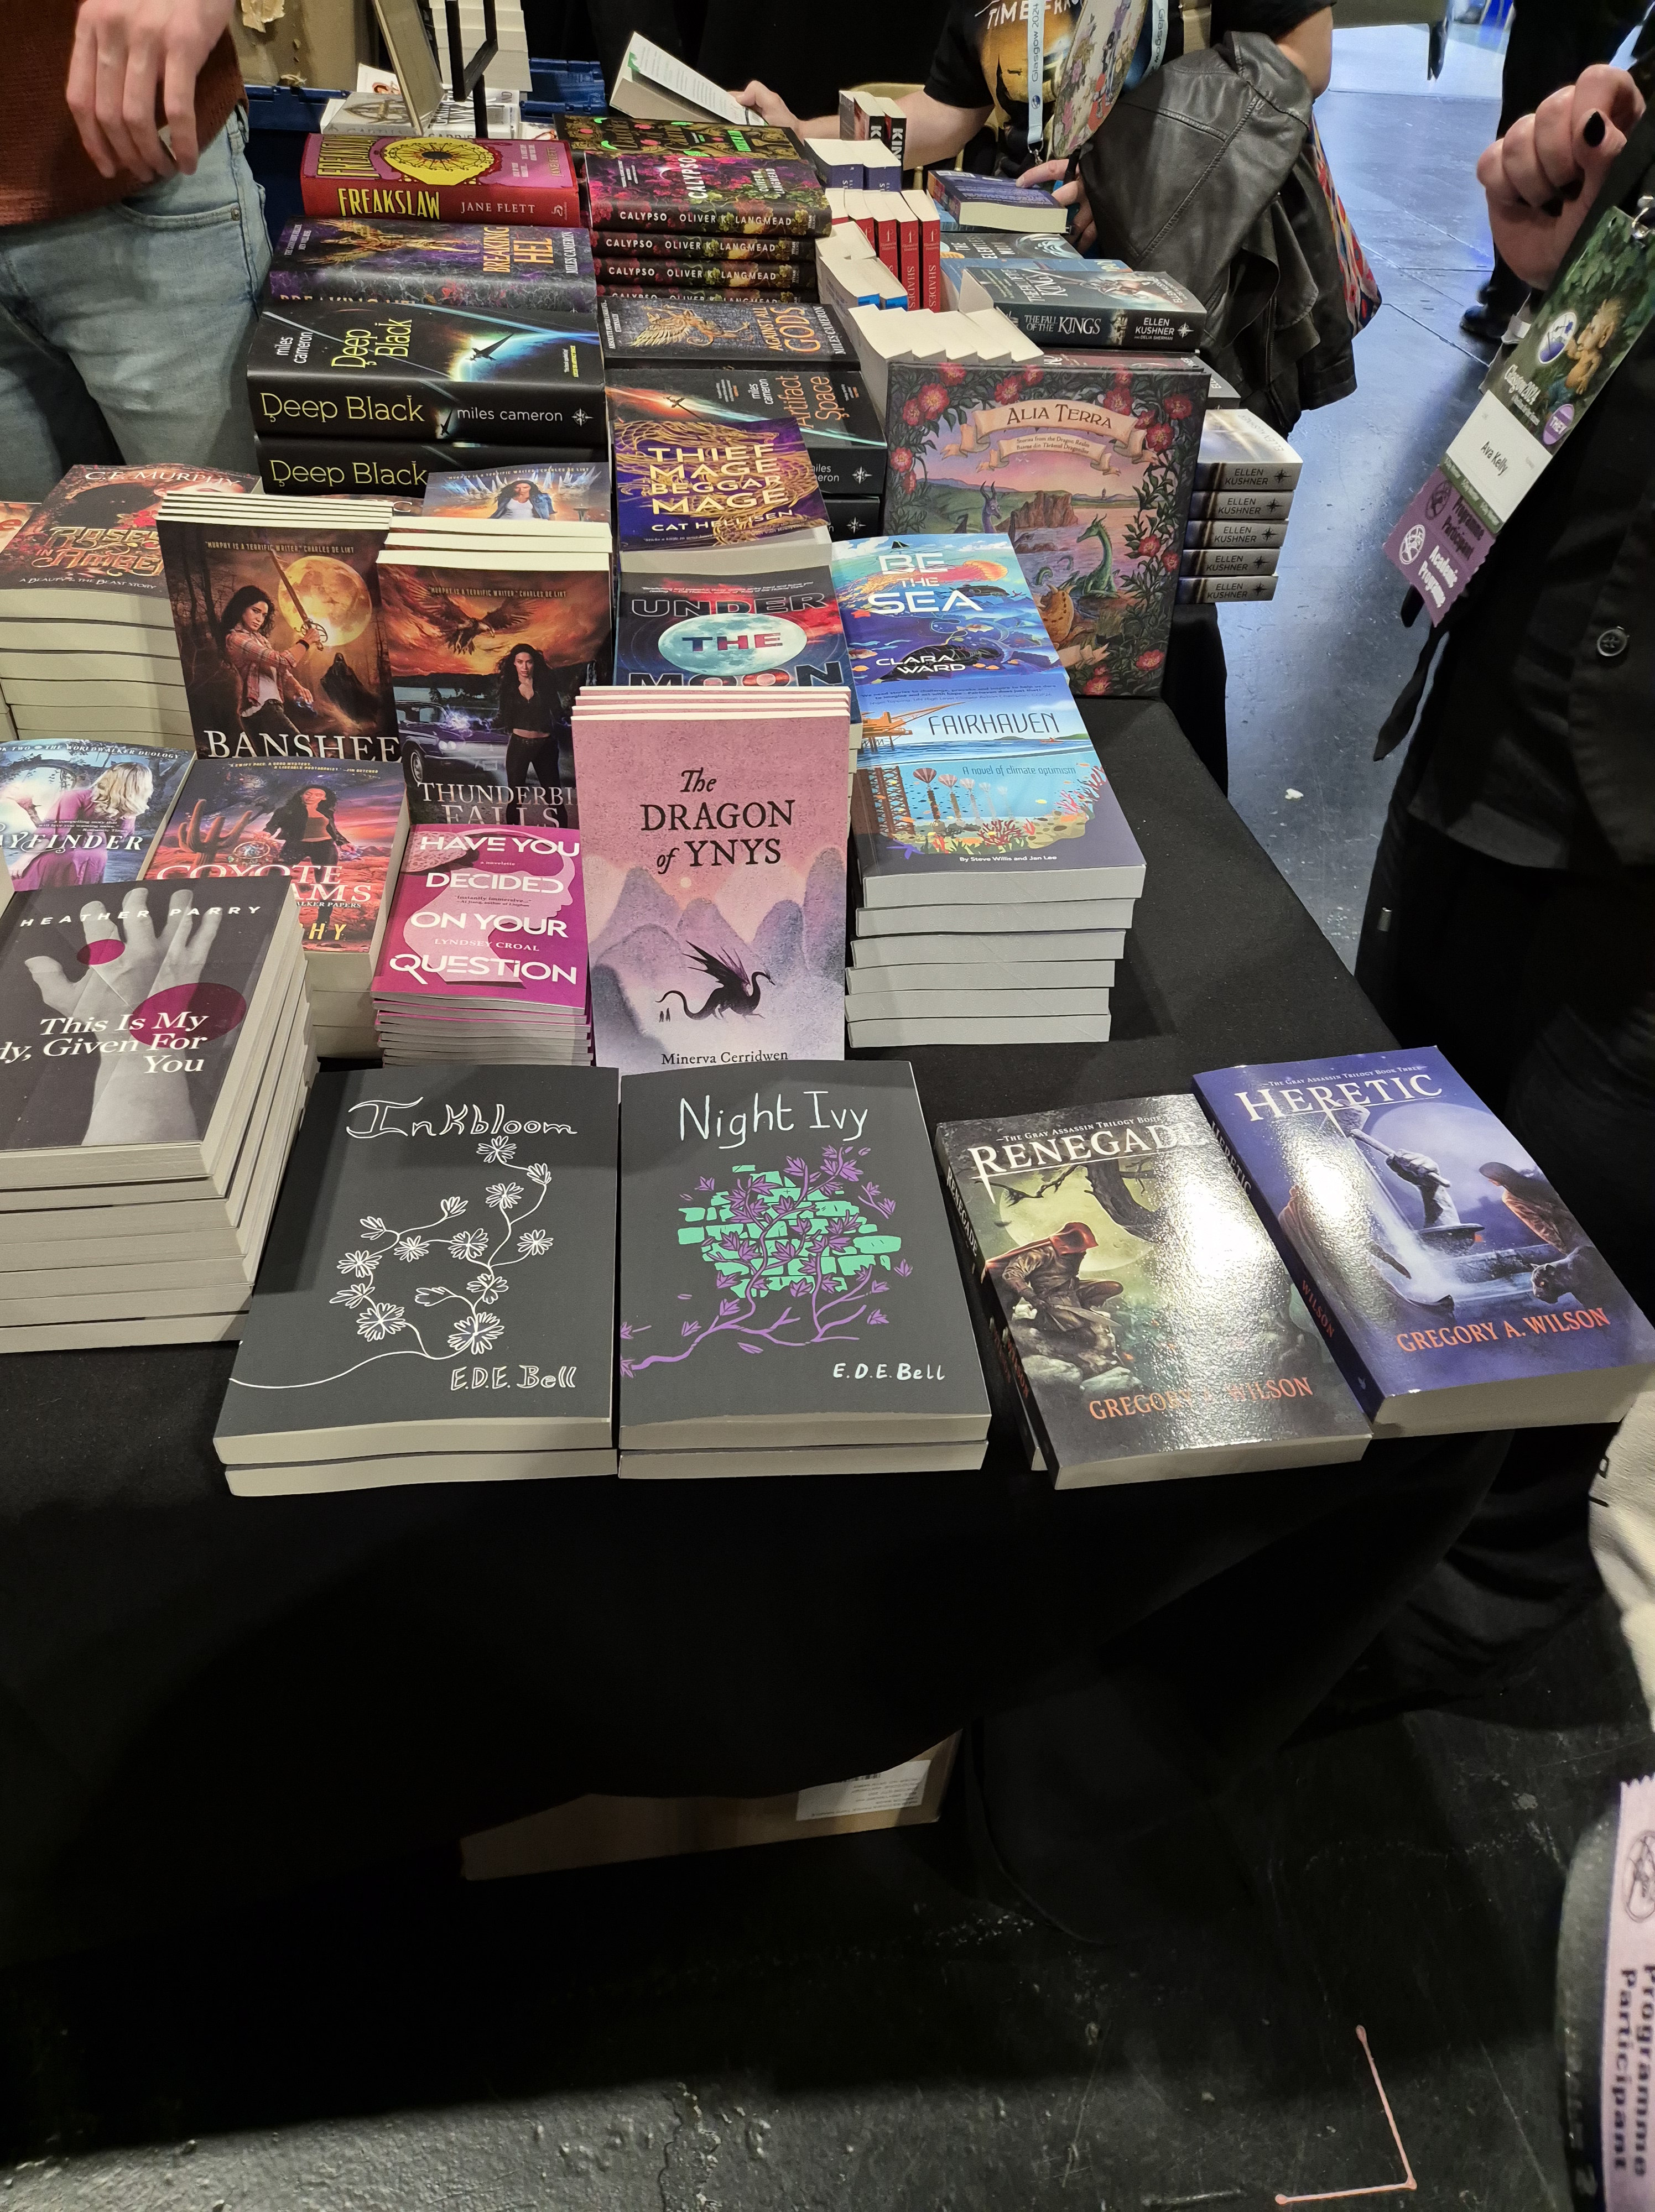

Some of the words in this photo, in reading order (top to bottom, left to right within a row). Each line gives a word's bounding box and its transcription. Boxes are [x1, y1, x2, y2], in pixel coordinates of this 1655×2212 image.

[1154, 8, 1165, 63] Glasgow
[1032, 31, 1040, 82] Glasgow
[678, 158, 709, 199] CALYPSO
[767, 168, 785, 194] LANGMEAD
[338, 188, 440, 220] FREAKSLAW
[461, 202, 492, 213] JANE
[497, 204, 535, 214] FLETT
[620, 211, 667, 221] CALYPSO
[679, 213, 716, 223] OLIVER
[736, 216, 792, 226] LANGMEAD
[483, 227, 511, 273] BREAKING
[513, 238, 554, 264] HEL
[562, 231, 576, 257] CAMERON
[606, 239, 653, 248] CALYPSO
[665, 241, 701, 250] OLIVER
[720, 242, 776, 252] LANGMEAD
[565, 257, 579, 274] MILES
[608, 267, 655, 276] CALYPSO
[667, 269, 702, 278] OLIVER
[721, 271, 776, 280] LANGMEAD
[907, 266, 915, 309] SHADES
[928, 265, 936, 308] SHADES
[1022, 273, 1068, 296] KINGS
[752, 307, 769, 319] ALL
[813, 306, 836, 335] CAMERON
[1040, 316, 1058, 324] FALL
[1143, 317, 1170, 326] ELLEN
[374, 318, 412, 357] Black
[757, 320, 784, 351] AGAINST
[770, 307, 820, 352] GODS
[1057, 317, 1101, 335] KINGS
[1135, 326, 1175, 335] KUSHNER
[274, 336, 294, 356] miles
[294, 332, 313, 364] cameron
[331, 329, 378, 368] Deep
[828, 334, 846, 354] MILES
[748, 383, 761, 399] miles
[759, 379, 774, 404] cameron
[776, 375, 814, 429] Artifact
[810, 376, 850, 420] Space
[261, 393, 338, 422] Deep
[347, 395, 425, 422] Black
[457, 407, 495, 420] miles
[500, 409, 563, 422] cameron
[1007, 408, 1050, 425] ALIA
[1055, 404, 1112, 429] TERRA
[648, 443, 774, 462] THIEF
[1075, 439, 1090, 448] Realm
[649, 458, 780, 480] MAGE
[1480, 441, 1497, 460] Ava
[1491, 451, 1509, 476] Kelly
[85, 472, 124, 481] C.E.
[133, 471, 242, 487] MURPHY
[270, 460, 345, 488] Deep
[353, 461, 428, 486] Black
[651, 475, 783, 495] BEGGAR
[652, 487, 789, 515] MAGE
[652, 523, 689, 531] CAT
[695, 509, 793, 529] HELLISEN
[878, 553, 948, 575] BE
[897, 577, 940, 588] THE
[631, 592, 829, 618] UNDER
[868, 590, 983, 614] SEA
[681, 632, 783, 652] THE
[876, 655, 955, 666] CLARA
[897, 664, 966, 675] WARD
[928, 713, 1060, 735] FAIRHAVEN
[66, 744, 135, 755] WORLDWALKER
[139, 750, 181, 759] DUOLOGY
[204, 730, 402, 763] BANSHEE
[680, 767, 717, 792] The
[962, 766, 969, 775] A
[971, 766, 994, 775] novel
[996, 765, 1005, 776] of
[1006, 765, 1036, 775] climate
[1038, 766, 1076, 776] optimism
[640, 799, 796, 831] DRAGON
[420, 836, 506, 852] HAVE
[511, 838, 580, 857] YOU
[657, 848, 680, 875] of
[684, 838, 781, 867] YNYS
[426, 872, 564, 894] DECIDED
[20, 909, 150, 927] HEATHER
[169, 906, 262, 916] PARRY
[410, 912, 467, 929] ON
[474, 913, 569, 938] YOUR
[434, 938, 492, 947] LYNDSEY
[496, 942, 539, 952] CROAL
[389, 953, 577, 985] QUESTION
[39, 1016, 108, 1036] This
[115, 1014, 146, 1032] Is
[152, 1011, 210, 1032] My
[43, 1037, 140, 1057] Given
[146, 1033, 209, 1050] For
[661, 1053, 717, 1065] Minerva
[720, 1050, 789, 1064] Cerridwen
[143, 1056, 205, 1074] You
[1308, 1074, 1341, 1083] ASSASSIN
[1343, 1071, 1374, 1079] TRILOGY
[1234, 1074, 1443, 1124] HERETIC
[680, 1093, 794, 1149] Night
[803, 1091, 868, 1141] Ivy
[1024, 1131, 1049, 1140] GRAY
[1052, 1123, 1094, 1135] ASSASSIN
[1096, 1118, 1134, 1128] TRILOGY
[946, 1164, 980, 1259] RENEGADE
[1302, 1279, 1335, 1338] WILSON
[1396, 1322, 1498, 1353] GREGORY
[1503, 1320, 1526, 1338] A.
[1523, 1307, 1611, 1335] WILSON
[450, 1366, 511, 1391] E.D.E.
[516, 1364, 577, 1389] Bell
[833, 1363, 892, 1379] E.D.E.
[897, 1363, 945, 1380] Bell
[1227, 1376, 1314, 1402] WILSON
[1612, 1968, 1637, 2171] Participant
